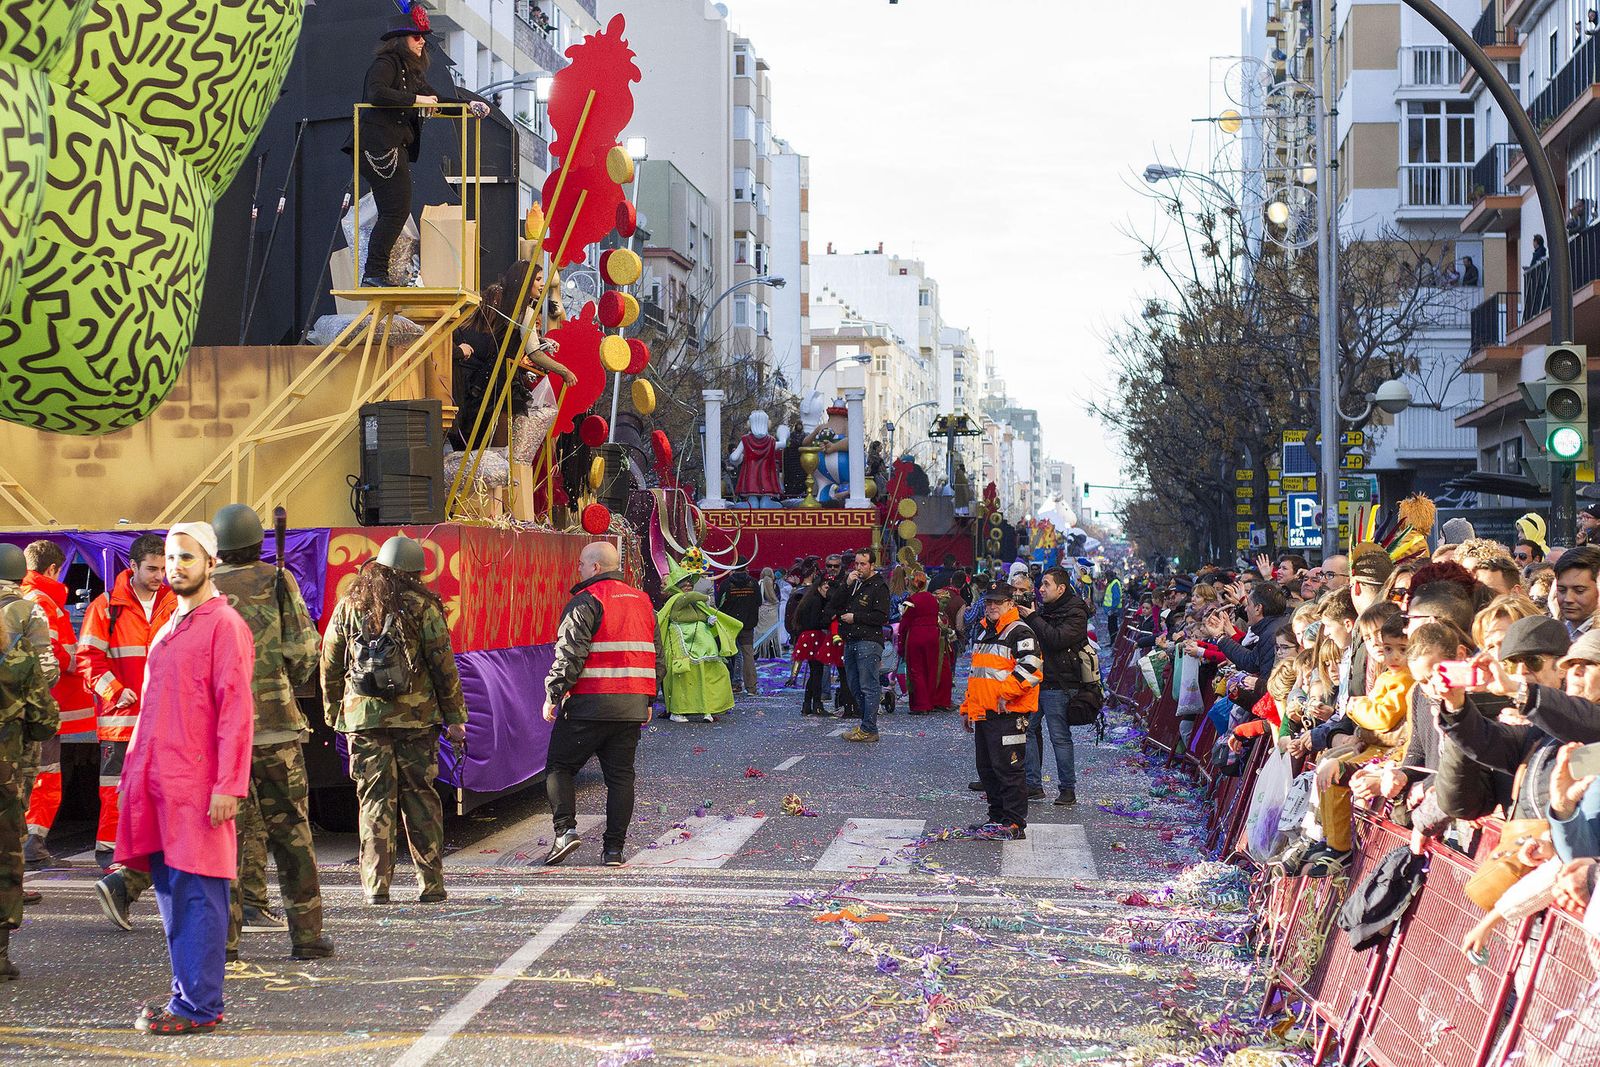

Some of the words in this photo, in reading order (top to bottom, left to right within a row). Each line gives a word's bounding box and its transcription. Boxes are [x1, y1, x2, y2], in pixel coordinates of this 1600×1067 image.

[1295, 498, 1316, 526] P
[1290, 537, 1305, 546] DEL
[1306, 536, 1322, 546] MAR
